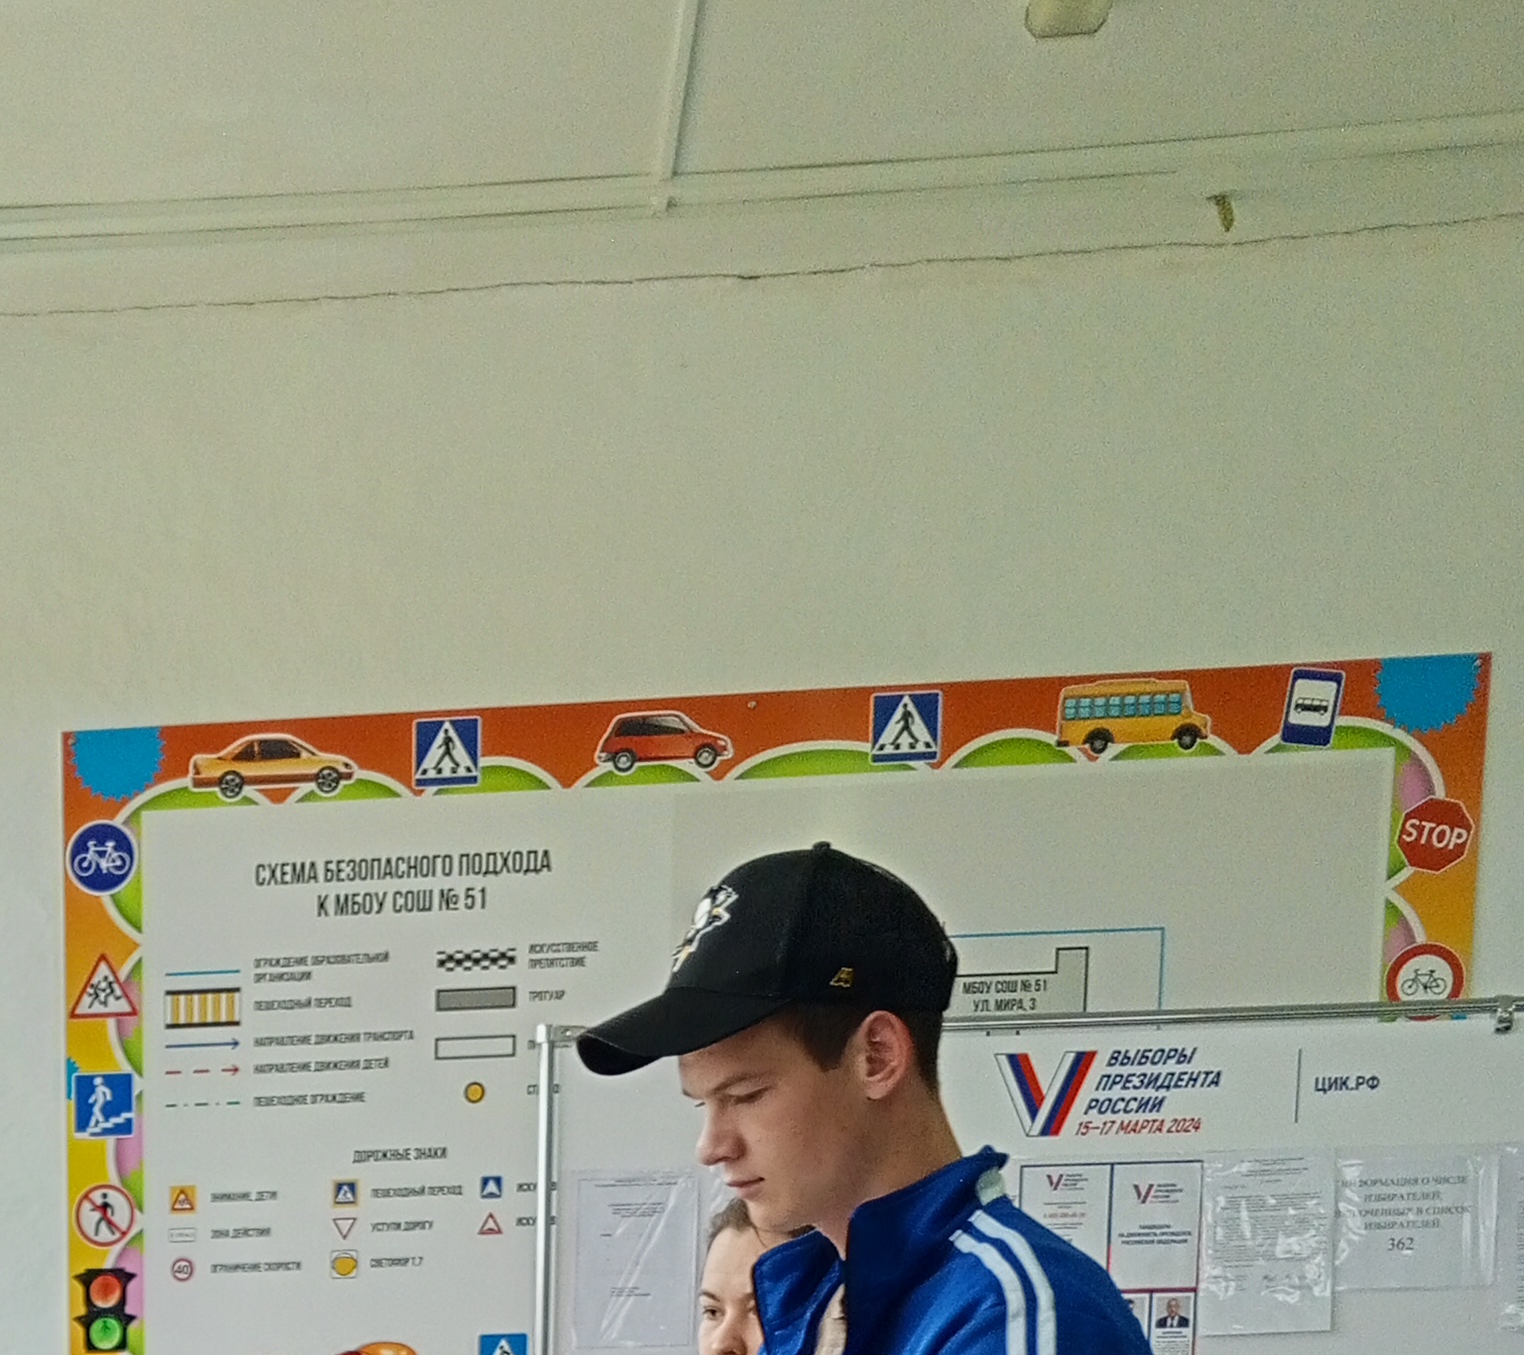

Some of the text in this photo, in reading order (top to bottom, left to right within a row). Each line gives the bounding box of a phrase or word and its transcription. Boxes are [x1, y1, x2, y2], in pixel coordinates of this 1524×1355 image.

[1401, 818, 1469, 852] STOP
[255, 849, 552, 887] СХЕМА БЕЗОПАСНОГО ПОДХОДА
[316, 886, 488, 917] К МБОУ СОШ № 51
[962, 981, 992, 994] МБОУ
[995, 980, 1018, 994] СОШ
[1034, 979, 1047, 992] 51
[1029, 998, 1037, 1010] 3
[1106, 1047, 1198, 1068] ВЫБОРЫ
[1095, 1070, 1223, 1092] ПРЕЗИДЕНТА
[1313, 1073, 1381, 1094] ЦИК.РФ
[1084, 1095, 1166, 1117] РОССИИ
[1115, 1118, 1165, 1136] МАРТА
[1166, 1117, 1203, 1135] 2024
[352, 1147, 448, 1163] ДОРОЖНЫЕ ЗНАКИ
[1387, 1237, 1414, 1251] 362
